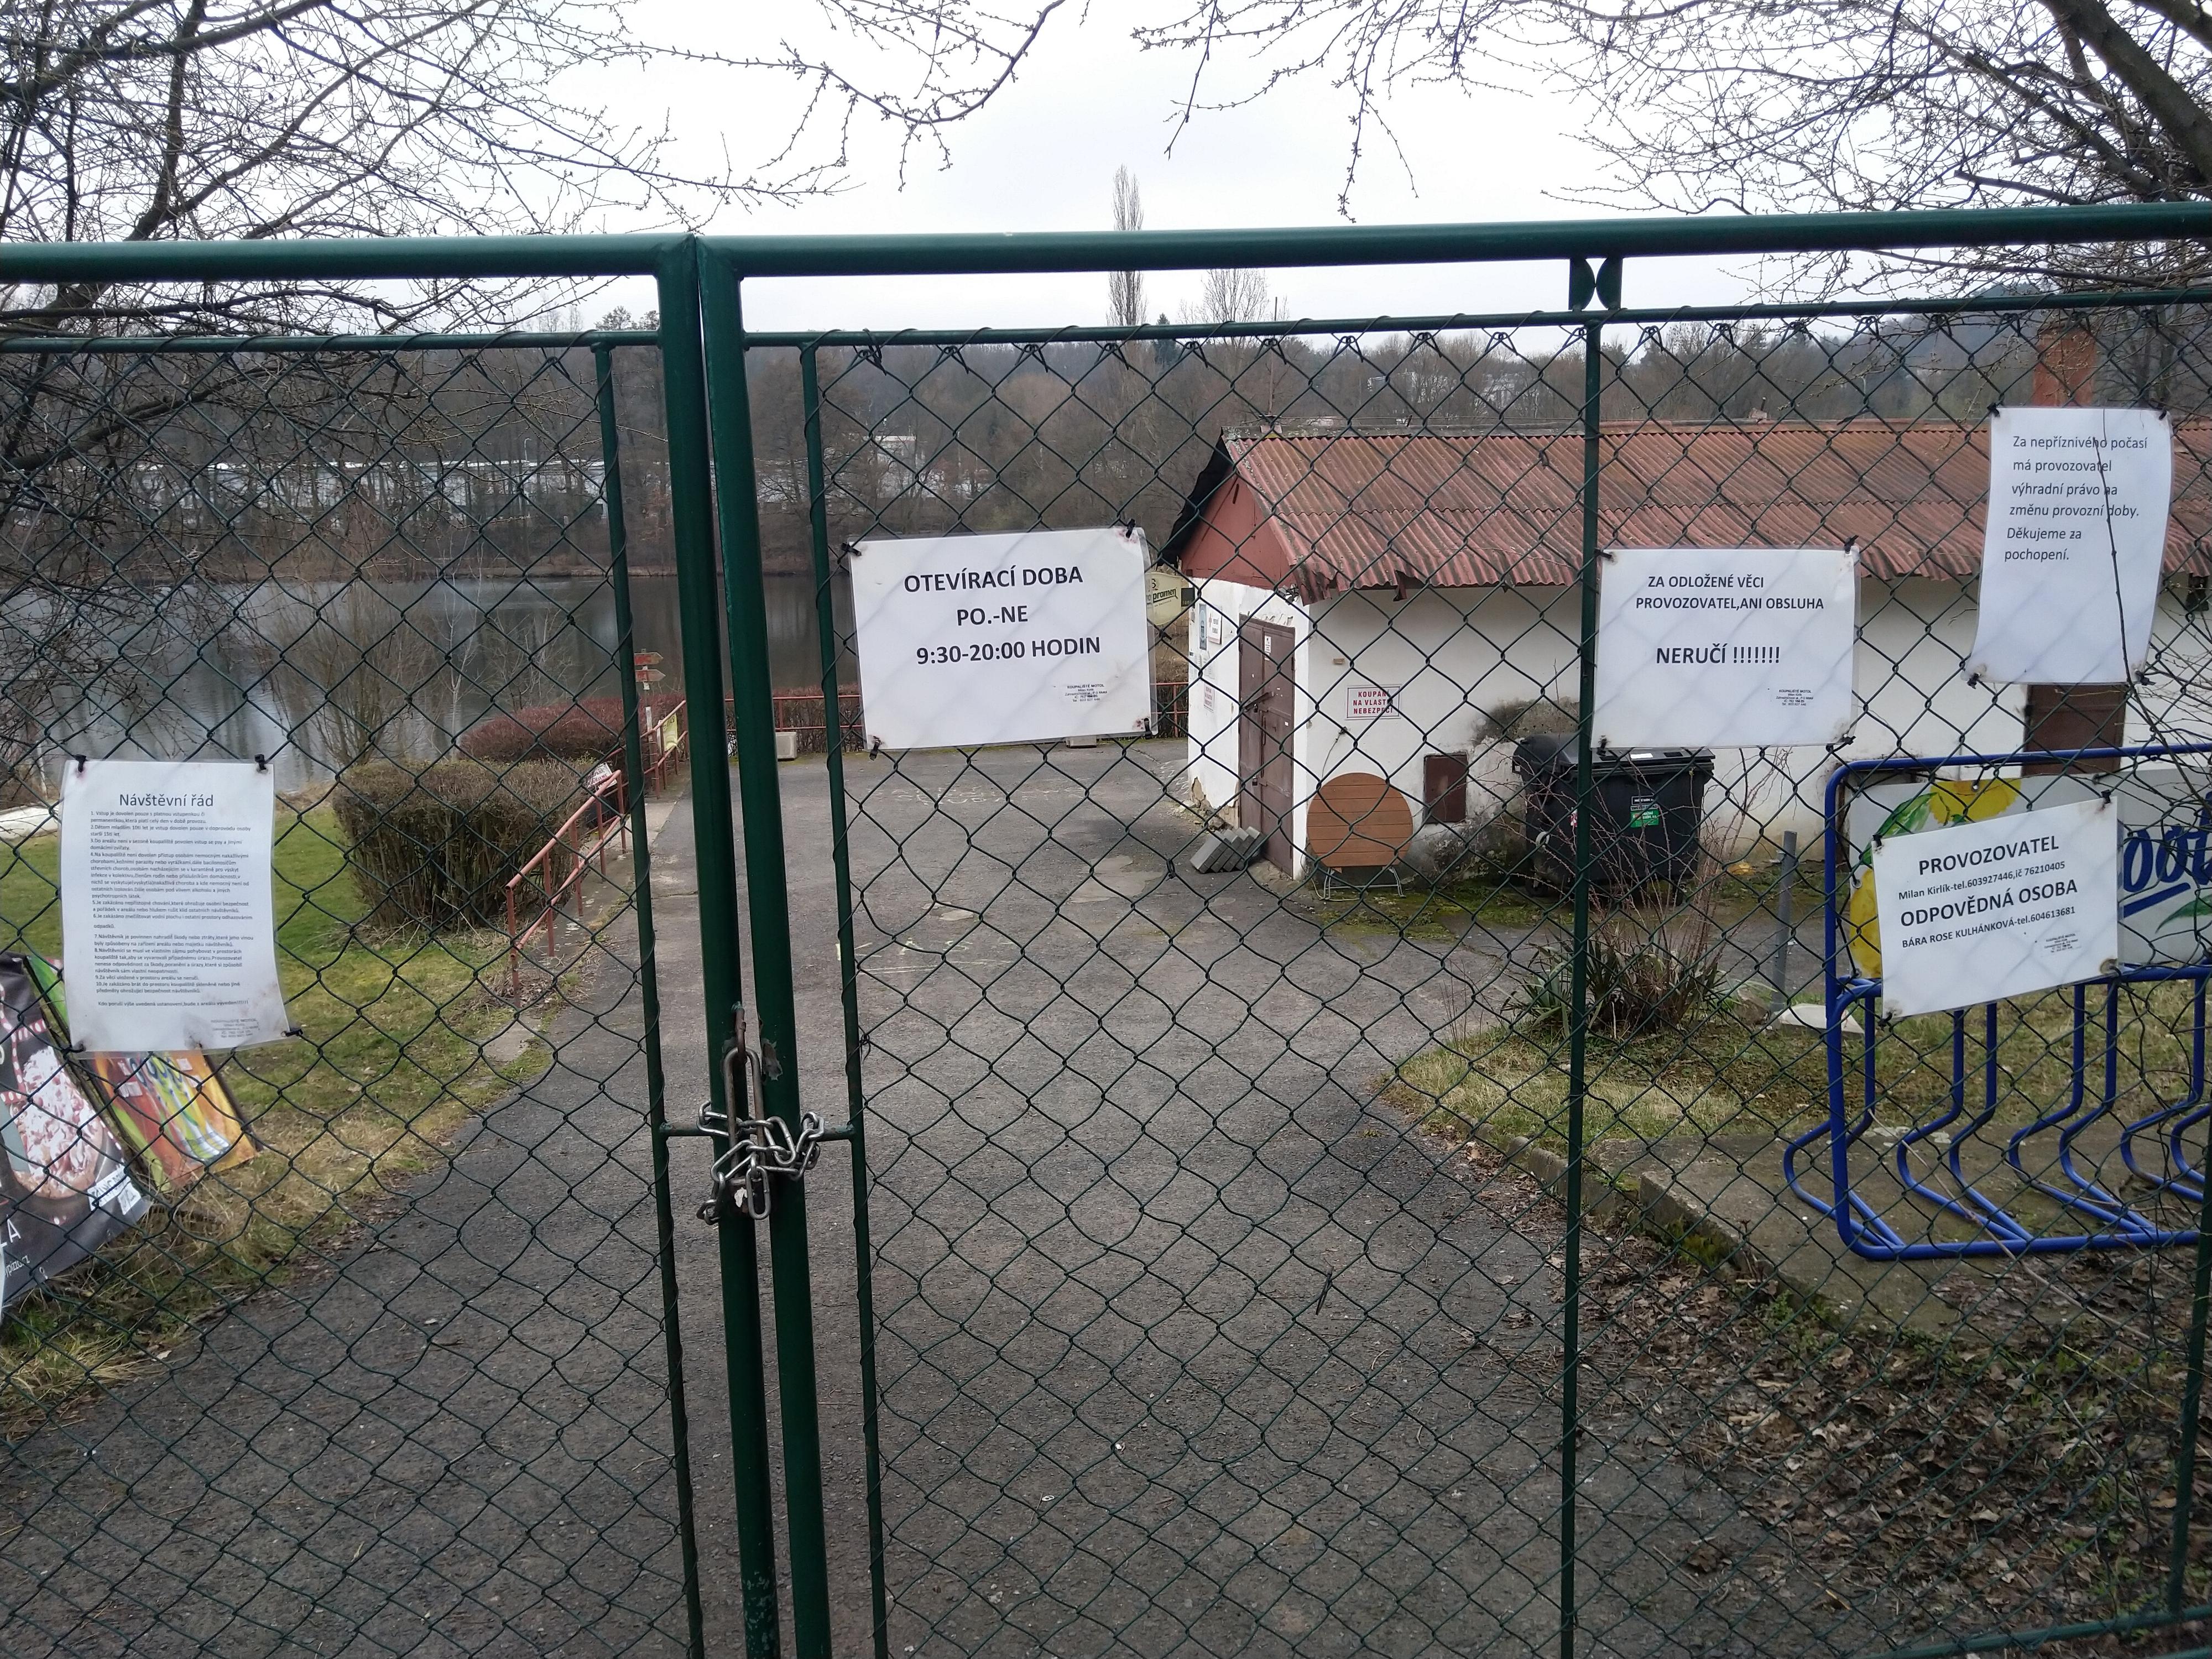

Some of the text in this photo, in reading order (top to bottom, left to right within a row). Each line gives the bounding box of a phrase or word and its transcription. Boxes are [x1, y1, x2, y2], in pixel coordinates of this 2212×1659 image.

[2013, 436, 2148, 451] Za nepříznivého počasí
[2013, 460, 2112, 473] má provozovatel
[2011, 483, 2117, 498] výhradní právo na
[2009, 504, 2140, 520] změnu provozní doby.
[2007, 526, 2082, 542] Děkujeme za
[2004, 549, 2070, 563] pochopení.
[904, 565, 1083, 592] OTEVÍRACÍ DOBA
[1648, 573, 1764, 588] ZA ODLOŽENÉ VĚCI
[1636, 597, 1824, 611] PROVOZOVATEL,ANI OBSLUHA
[957, 605, 1029, 626] PO.-NE
[916, 637, 1100, 665] 9:30-20:00 HODIN
[1656, 643, 1726, 664] NERUČÍ
[119, 793, 213, 807] Návštěvní řád
[1918, 836, 2060, 875] PROVOZOVATEL
[1898, 861, 2065, 900] Milan Kirlík-tel.603927446,ič 76210405
[1900, 879, 2078, 927] ODPOVĚDNÁ OSOBA
[1902, 906, 2075, 948] BÁRA ROSE KULHÁNKOVÁ-tel.604613681
